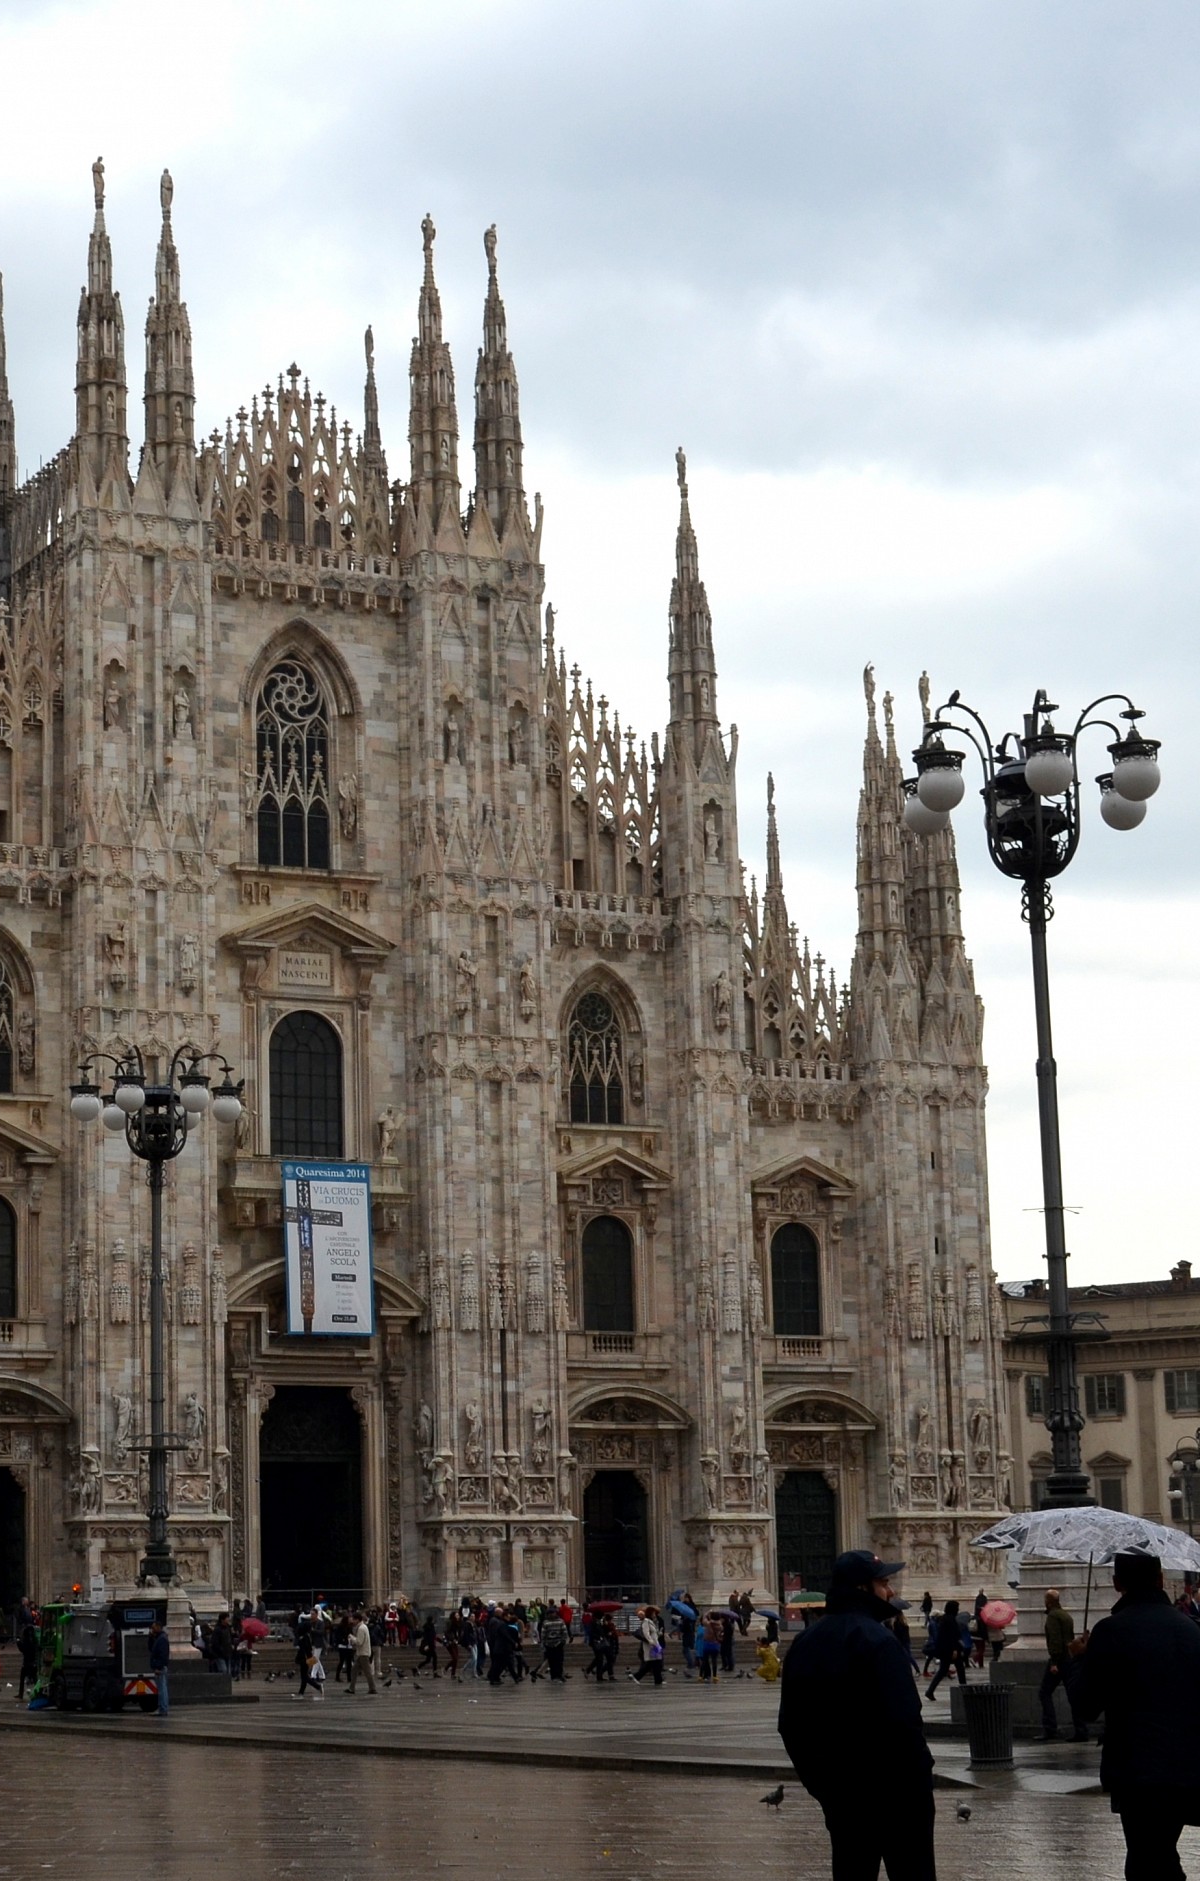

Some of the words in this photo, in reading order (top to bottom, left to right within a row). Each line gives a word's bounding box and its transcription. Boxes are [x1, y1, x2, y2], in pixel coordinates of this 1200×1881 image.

[285, 956, 324, 967] MARIAE
[280, 969, 329, 980] NASCENTI
[295, 1166, 344, 1178] Quaresima
[346, 1169, 366, 1178] 2014
[312, 1186, 329, 1195] VIA
[331, 1187, 365, 1196] CRUCIS
[324, 1196, 360, 1206] DUOMO
[326, 1248, 360, 1257] ANGELO
[330, 1258, 357, 1266] SCOLA
